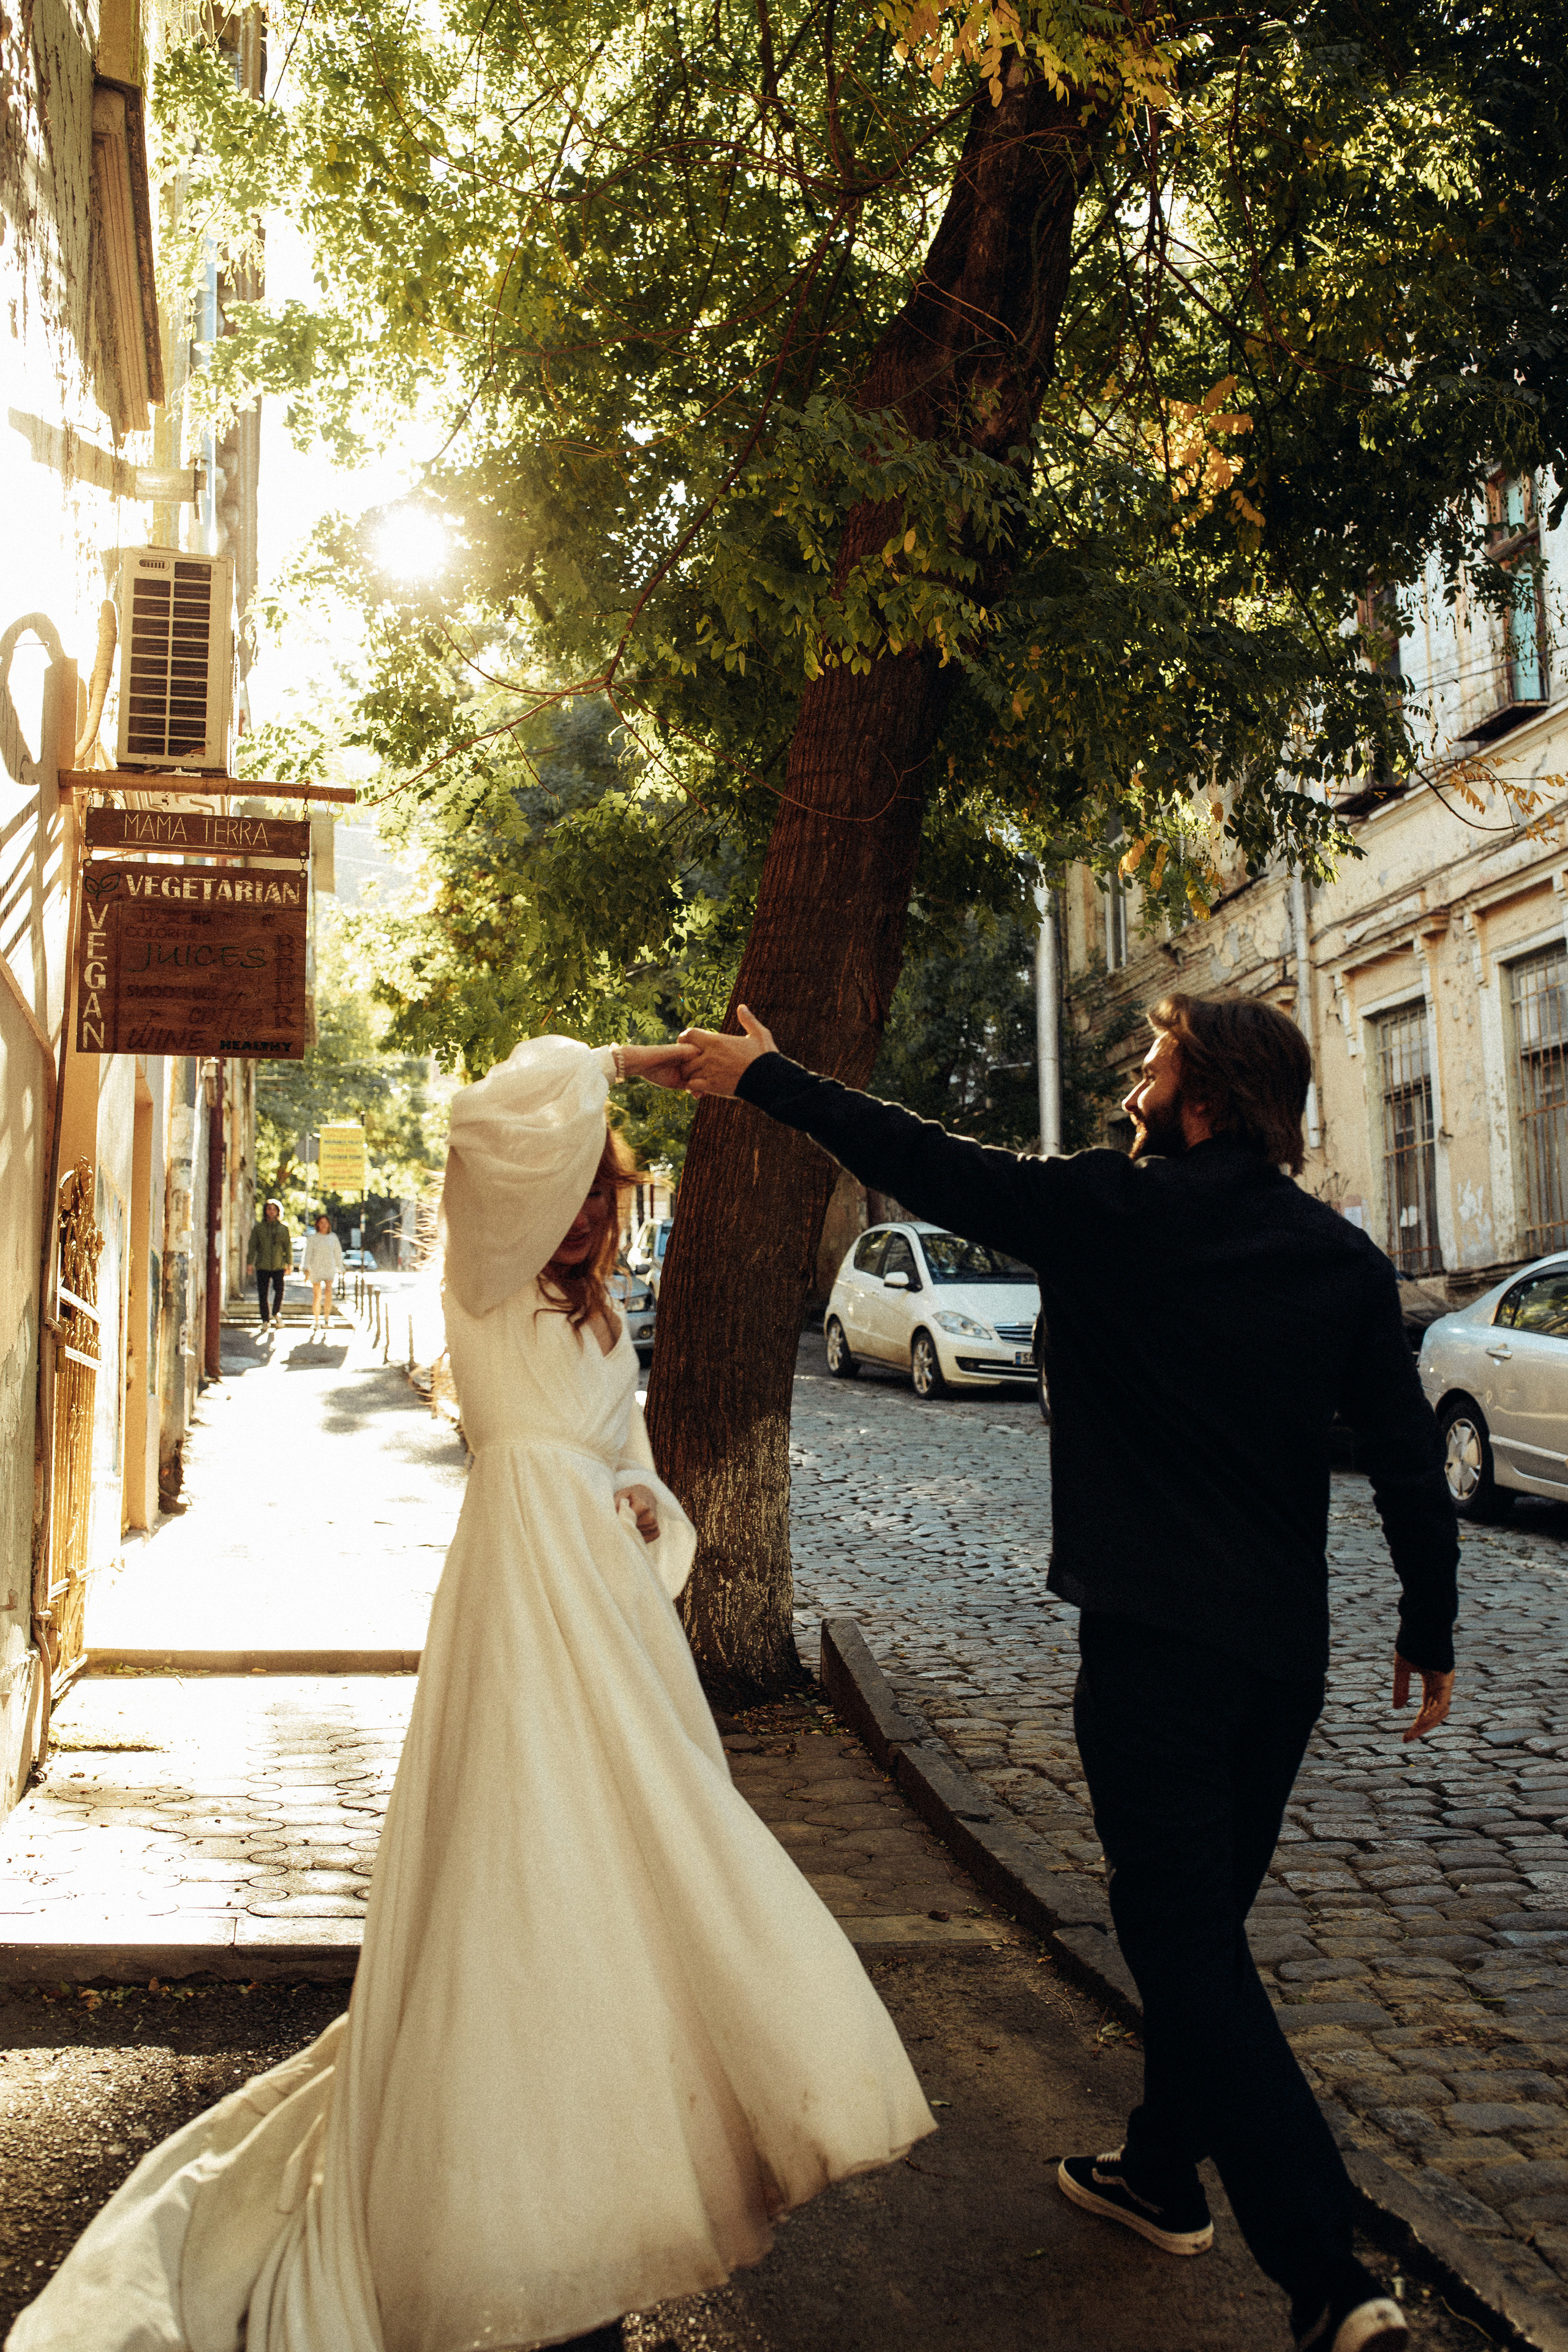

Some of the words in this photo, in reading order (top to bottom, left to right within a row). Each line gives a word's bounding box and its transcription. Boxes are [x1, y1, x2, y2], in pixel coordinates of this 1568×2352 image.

[124, 813, 187, 842] MAMA
[202, 818, 269, 846] TERRA
[126, 874, 301, 904] VEGETARIAN
[127, 943, 267, 973] JUICES
[82, 902, 109, 1049] VEGAN
[273, 933, 296, 1030] BEER
[126, 1027, 207, 1050] WINE
[219, 1040, 293, 1052] HEALTHY
